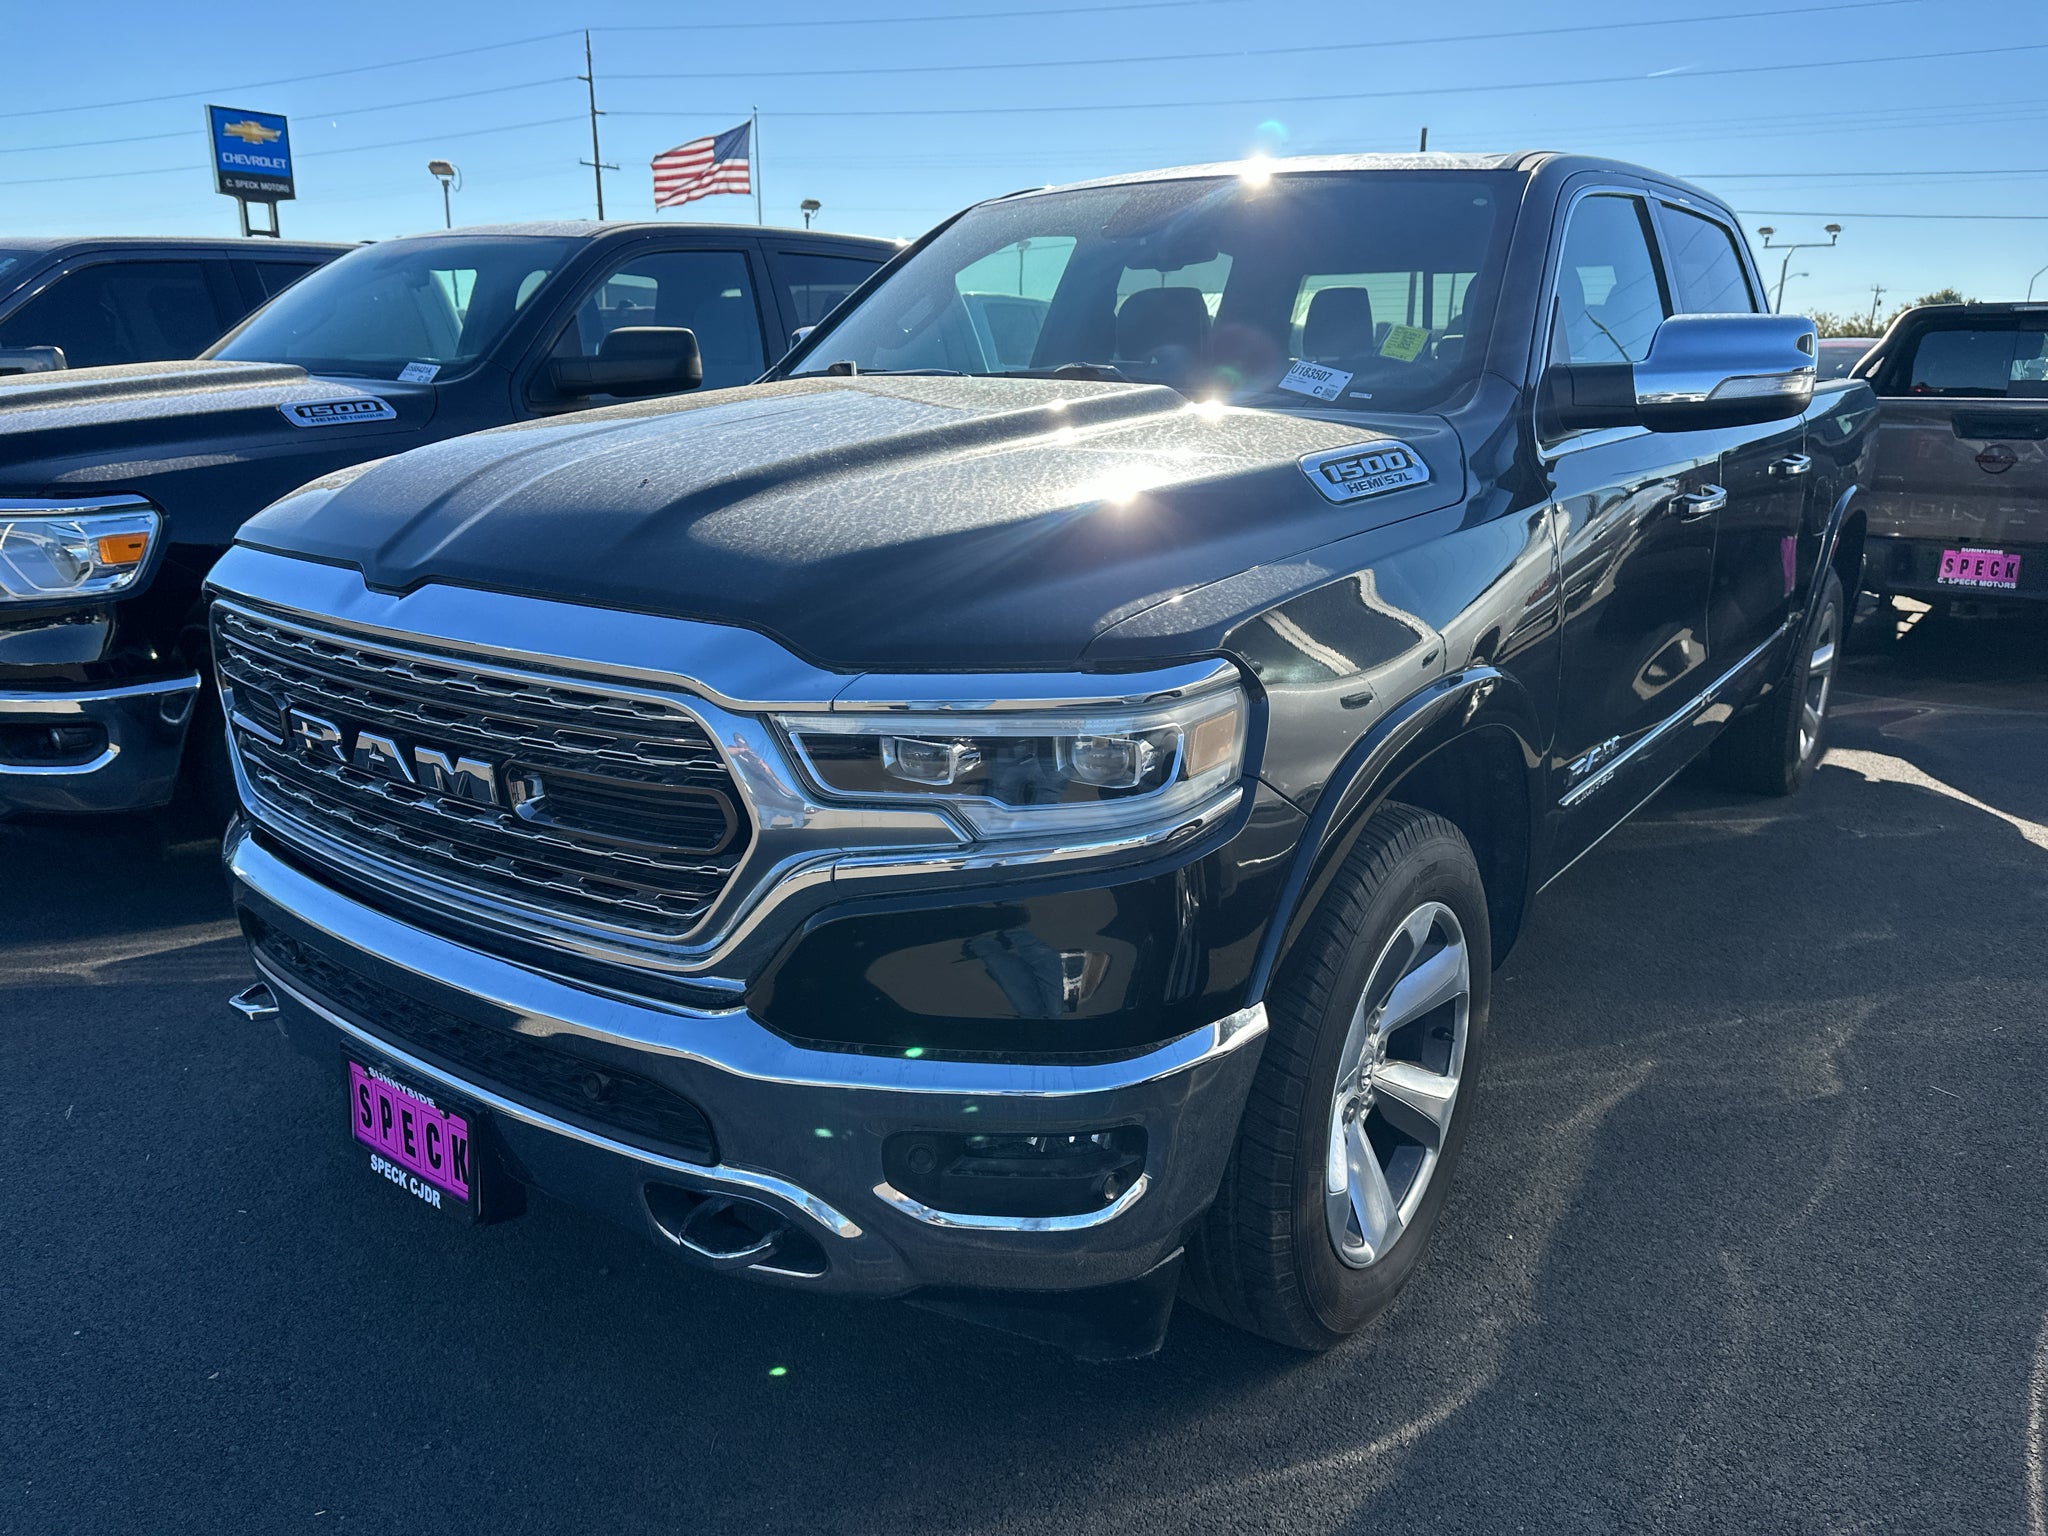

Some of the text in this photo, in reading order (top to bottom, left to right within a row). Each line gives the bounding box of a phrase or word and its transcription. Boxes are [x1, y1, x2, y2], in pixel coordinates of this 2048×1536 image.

[222, 151, 287, 169] CHEVROLET
[235, 179, 260, 190] SPECK
[260, 182, 290, 193] MOTORS
[1290, 363, 1334, 383] U183507
[300, 401, 378, 417] 1500
[1322, 450, 1408, 483] 1500
[1345, 470, 1413, 494] HEMI 5.7L
[1961, 547, 2004, 555] SUNNYSIDE
[1944, 557, 2017, 579] SPECK
[1978, 579, 2017, 589] MOTORS
[289, 707, 500, 805] RAM
[368, 1066, 437, 1109] SUNNYSIDE
[358, 1083, 469, 1186] SPECK
[370, 1153, 442, 1210] SPECK CJDR
